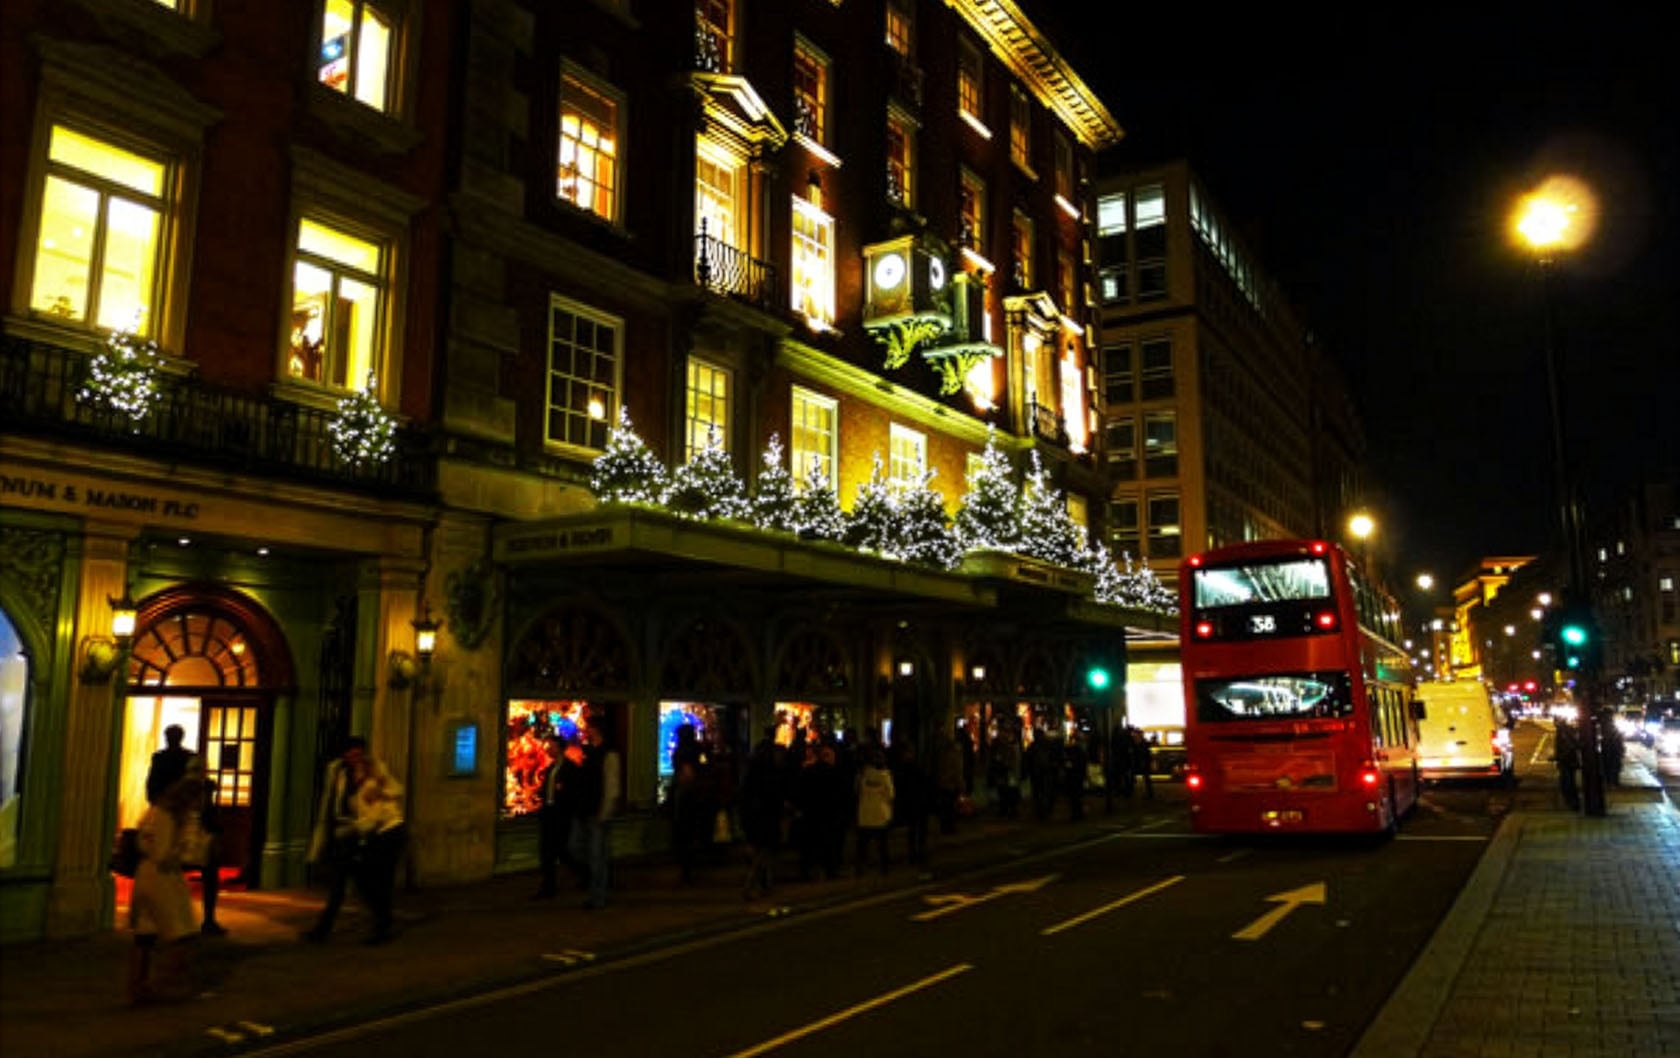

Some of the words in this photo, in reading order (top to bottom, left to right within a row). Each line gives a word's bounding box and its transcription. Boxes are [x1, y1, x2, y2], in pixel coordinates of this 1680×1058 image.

[63, 485, 77, 502] &
[86, 489, 158, 513] MASON
[163, 500, 200, 518] PLC
